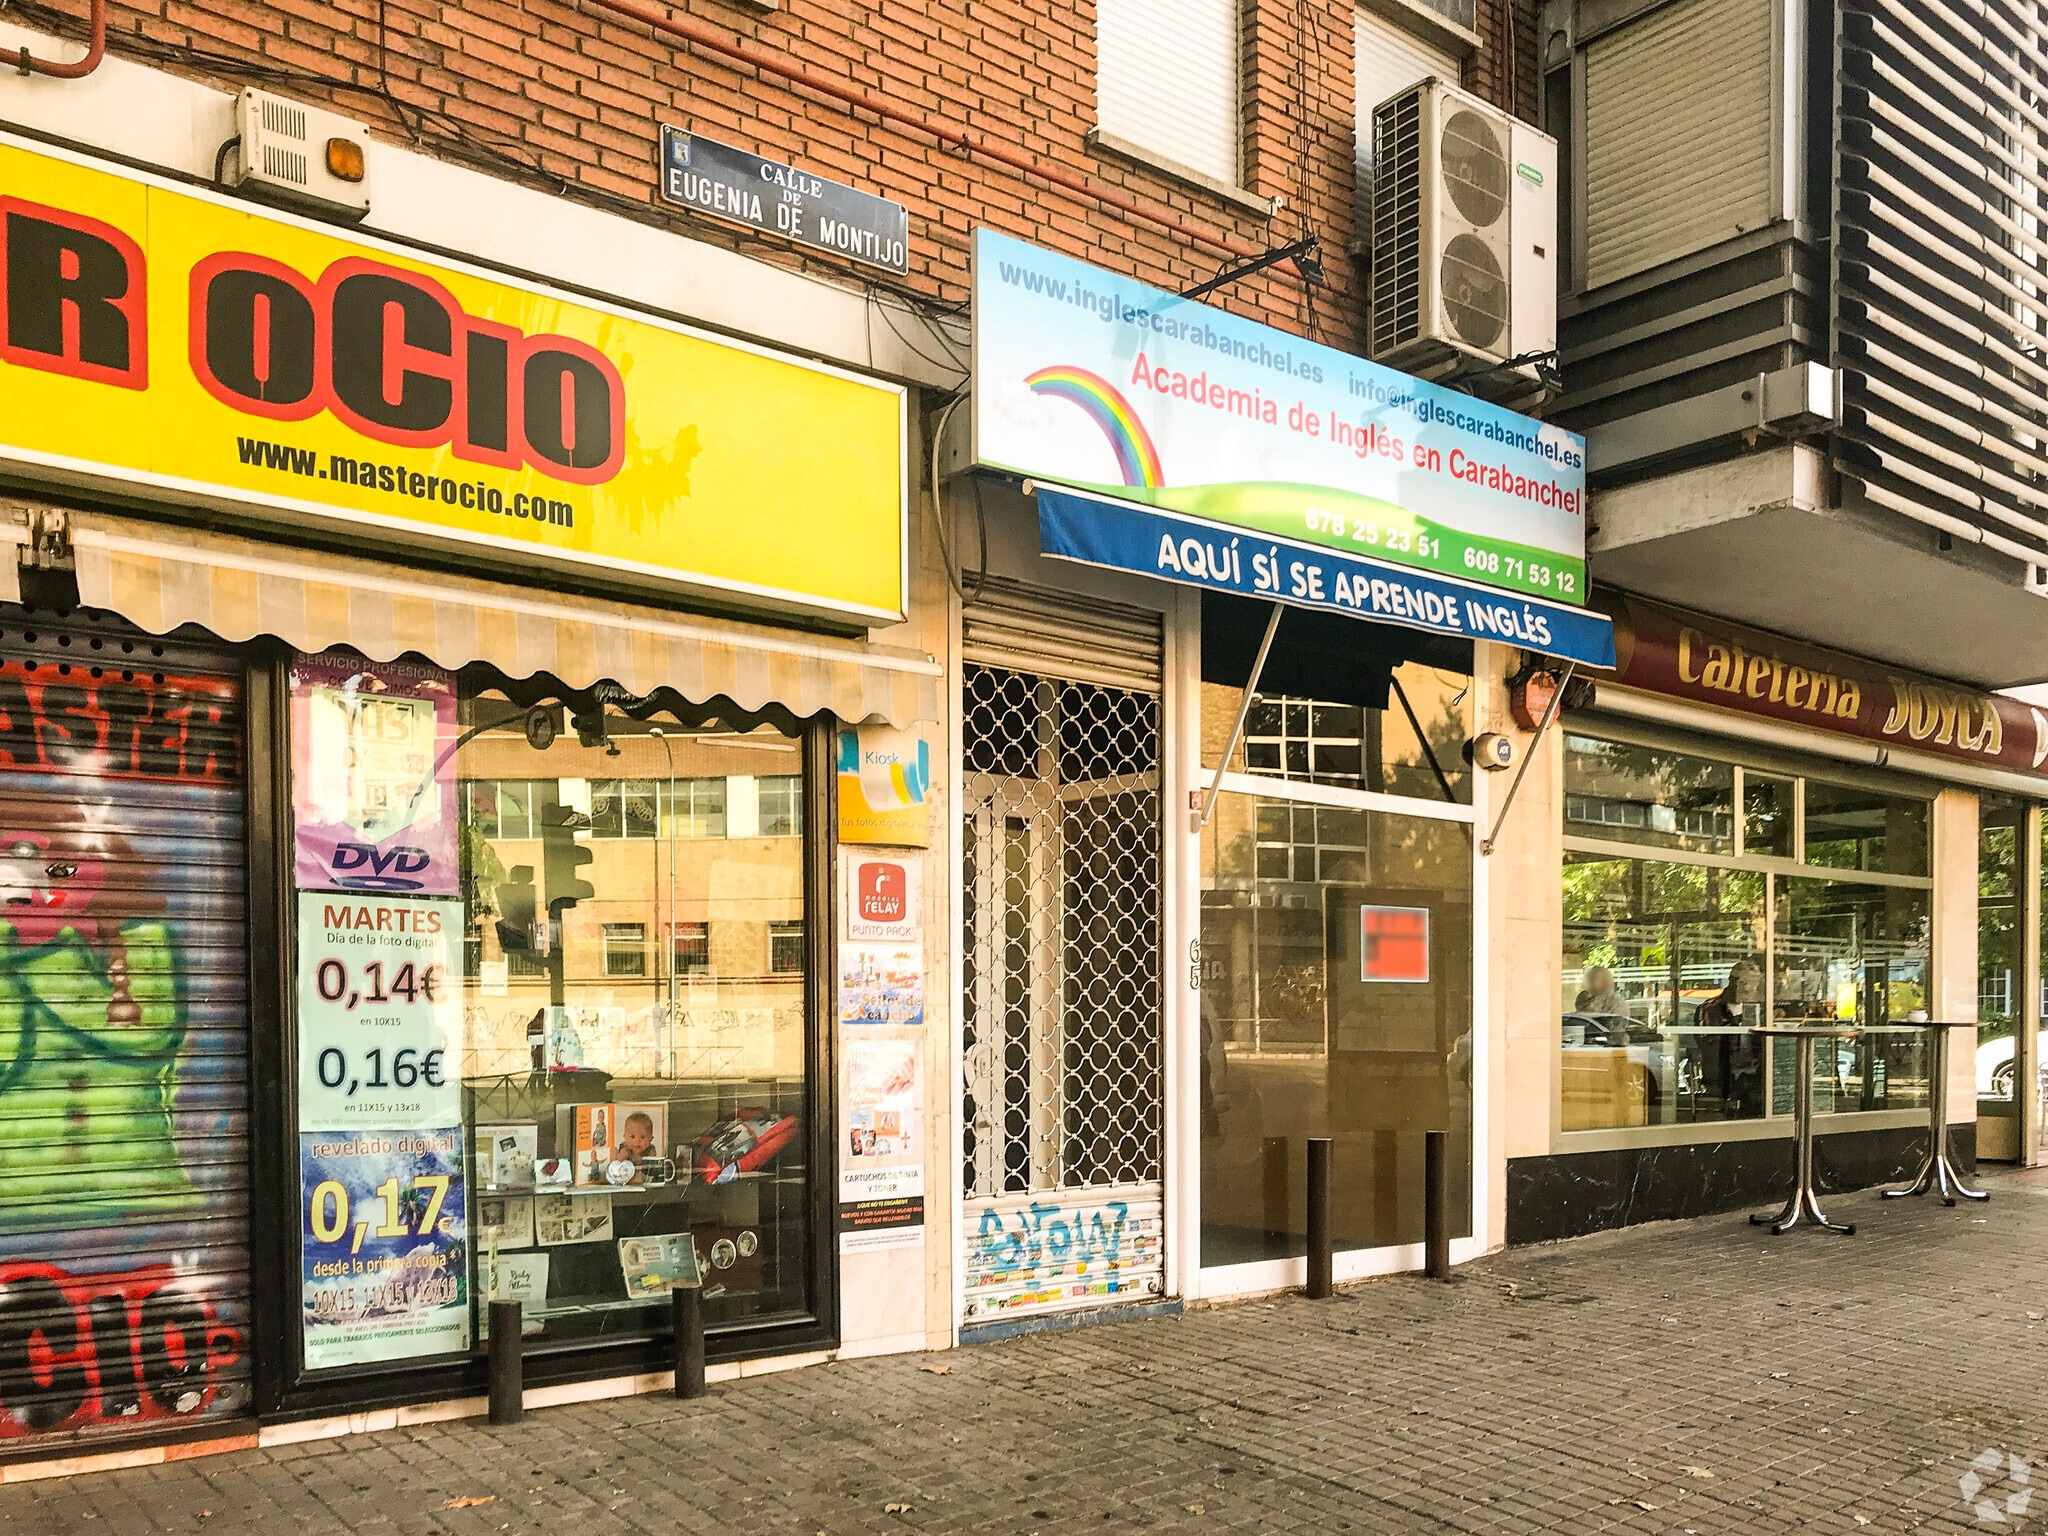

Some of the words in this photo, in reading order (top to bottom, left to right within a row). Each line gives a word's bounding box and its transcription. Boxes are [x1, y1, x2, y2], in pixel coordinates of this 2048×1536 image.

[760, 163, 823, 199] CALLE
[783, 189, 802, 206] DE
[669, 167, 763, 223] EUGENIA
[777, 203, 803, 236] DE
[819, 216, 904, 268] MONTIJO
[999, 260, 1324, 384] www.inglescarabanchel.es
[1349, 371, 1582, 470] info@inglescarabanchel.es
[1131, 351, 1278, 426] Academia
[1288, 401, 1320, 437] de
[1330, 411, 1404, 461] Inglés
[1413, 444, 1441, 473] en
[1449, 449, 1581, 516] Carabanchel
[236, 436, 574, 528] www.masterocio.com
[1304, 508, 1345, 537] 678
[1352, 519, 1380, 545] 25
[1385, 527, 1411, 553] 23
[1417, 535, 1440, 560] 51
[1463, 546, 1499, 574] 608
[1504, 556, 1524, 580] 71
[1528, 562, 1551, 586] 53
[1555, 570, 1576, 593] 12
[1157, 532, 1242, 585] AQUÍ
[1252, 546, 1280, 592] SÍ
[1290, 561, 1325, 600] SE
[1334, 570, 1459, 628] APRENDE
[1466, 599, 1552, 646] INGLÉS
[298, 652, 359, 671] SERVICIO
[362, 660, 450, 682] PROFESIONAL
[1882, 676, 2004, 756] JOYCA
[865, 751, 899, 766] Kiosk
[331, 842, 431, 877] DVD
[323, 904, 442, 934] MARTES
[886, 926, 912, 937] PACK
[327, 933, 346, 945] Día
[349, 934, 363, 945] de
[367, 933, 376, 945] la
[379, 935, 402, 947] foto
[317, 959, 444, 1010] 0,14€
[867, 1009, 915, 1021] caucho
[906, 994, 922, 1007] de
[374, 1017, 402, 1026] 10X15
[318, 1047, 446, 1096] 0,16€
[387, 1105, 393, 1113] y
[311, 1137, 393, 1158] revelado
[397, 1134, 455, 1157] digital
[844, 1172, 887, 1184] CARTUCHOS
[899, 1170, 919, 1179] TNTA
[868, 1185, 873, 1193] Y
[874, 1184, 898, 1193] TONER
[313, 1260, 350, 1277] desde
[353, 1257, 364, 1275] la
[367, 1256, 412, 1276] primera
